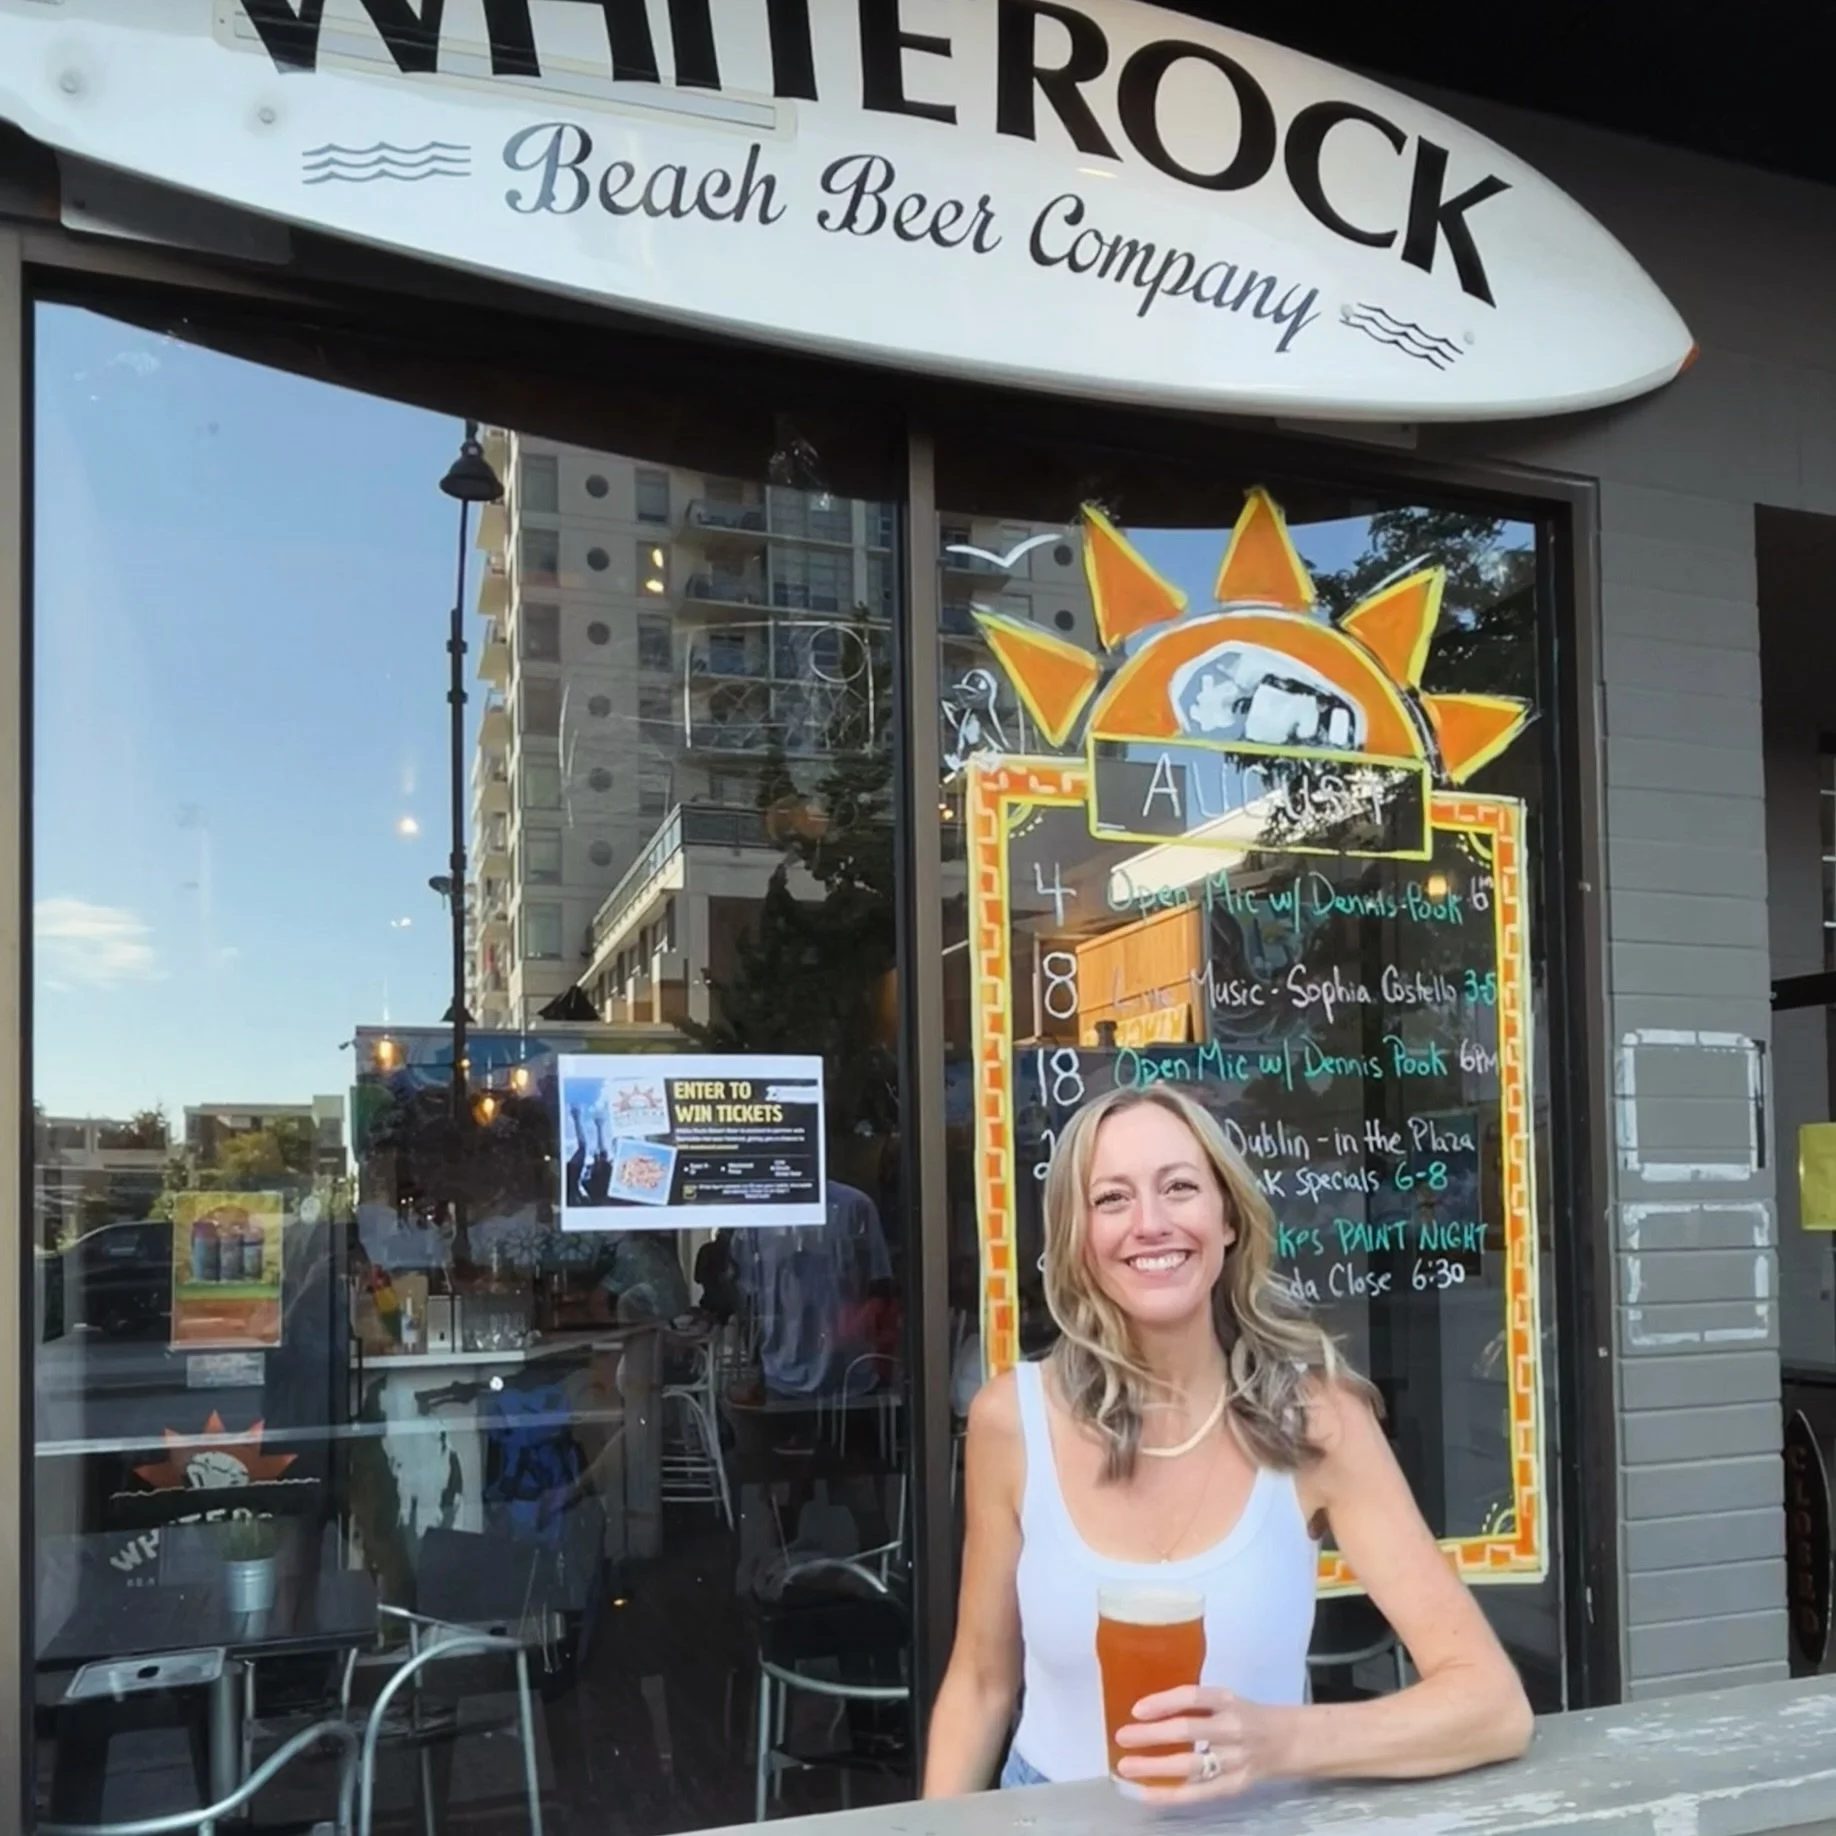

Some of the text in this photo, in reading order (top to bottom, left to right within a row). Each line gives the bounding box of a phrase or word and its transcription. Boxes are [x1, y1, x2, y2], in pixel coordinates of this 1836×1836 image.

[502, 122, 1322, 353] Beach Beer Company
[1033, 862, 1077, 928] 4
[1107, 868, 1190, 924] Open
[1287, 963, 1372, 1025] Sophia
[1380, 963, 1458, 1006] Costello
[673, 1081, 752, 1100] ENTER TO
[1037, 1047, 1085, 1106] 18
[1114, 1049, 1192, 1092] Open
[1198, 1037, 1249, 1081] Mic
[1303, 1034, 1384, 1080] Dennis
[1382, 1034, 1449, 1077] Pook
[675, 1104, 713, 1123] WIN
[716, 1104, 784, 1123] TICKETS
[1224, 1118, 1311, 1161] Dublin
[1334, 1127, 1360, 1156] in
[1364, 1118, 1407, 1155] the
[1408, 1116, 1477, 1153] Plaza
[1395, 1161, 1449, 1192] 6-8
[1333, 1218, 1409, 1257] PAINT
[1410, 1220, 1491, 1255] NIGHT
[1328, 1262, 1394, 1297] Close
[1411, 1258, 1467, 1293] 6:30
